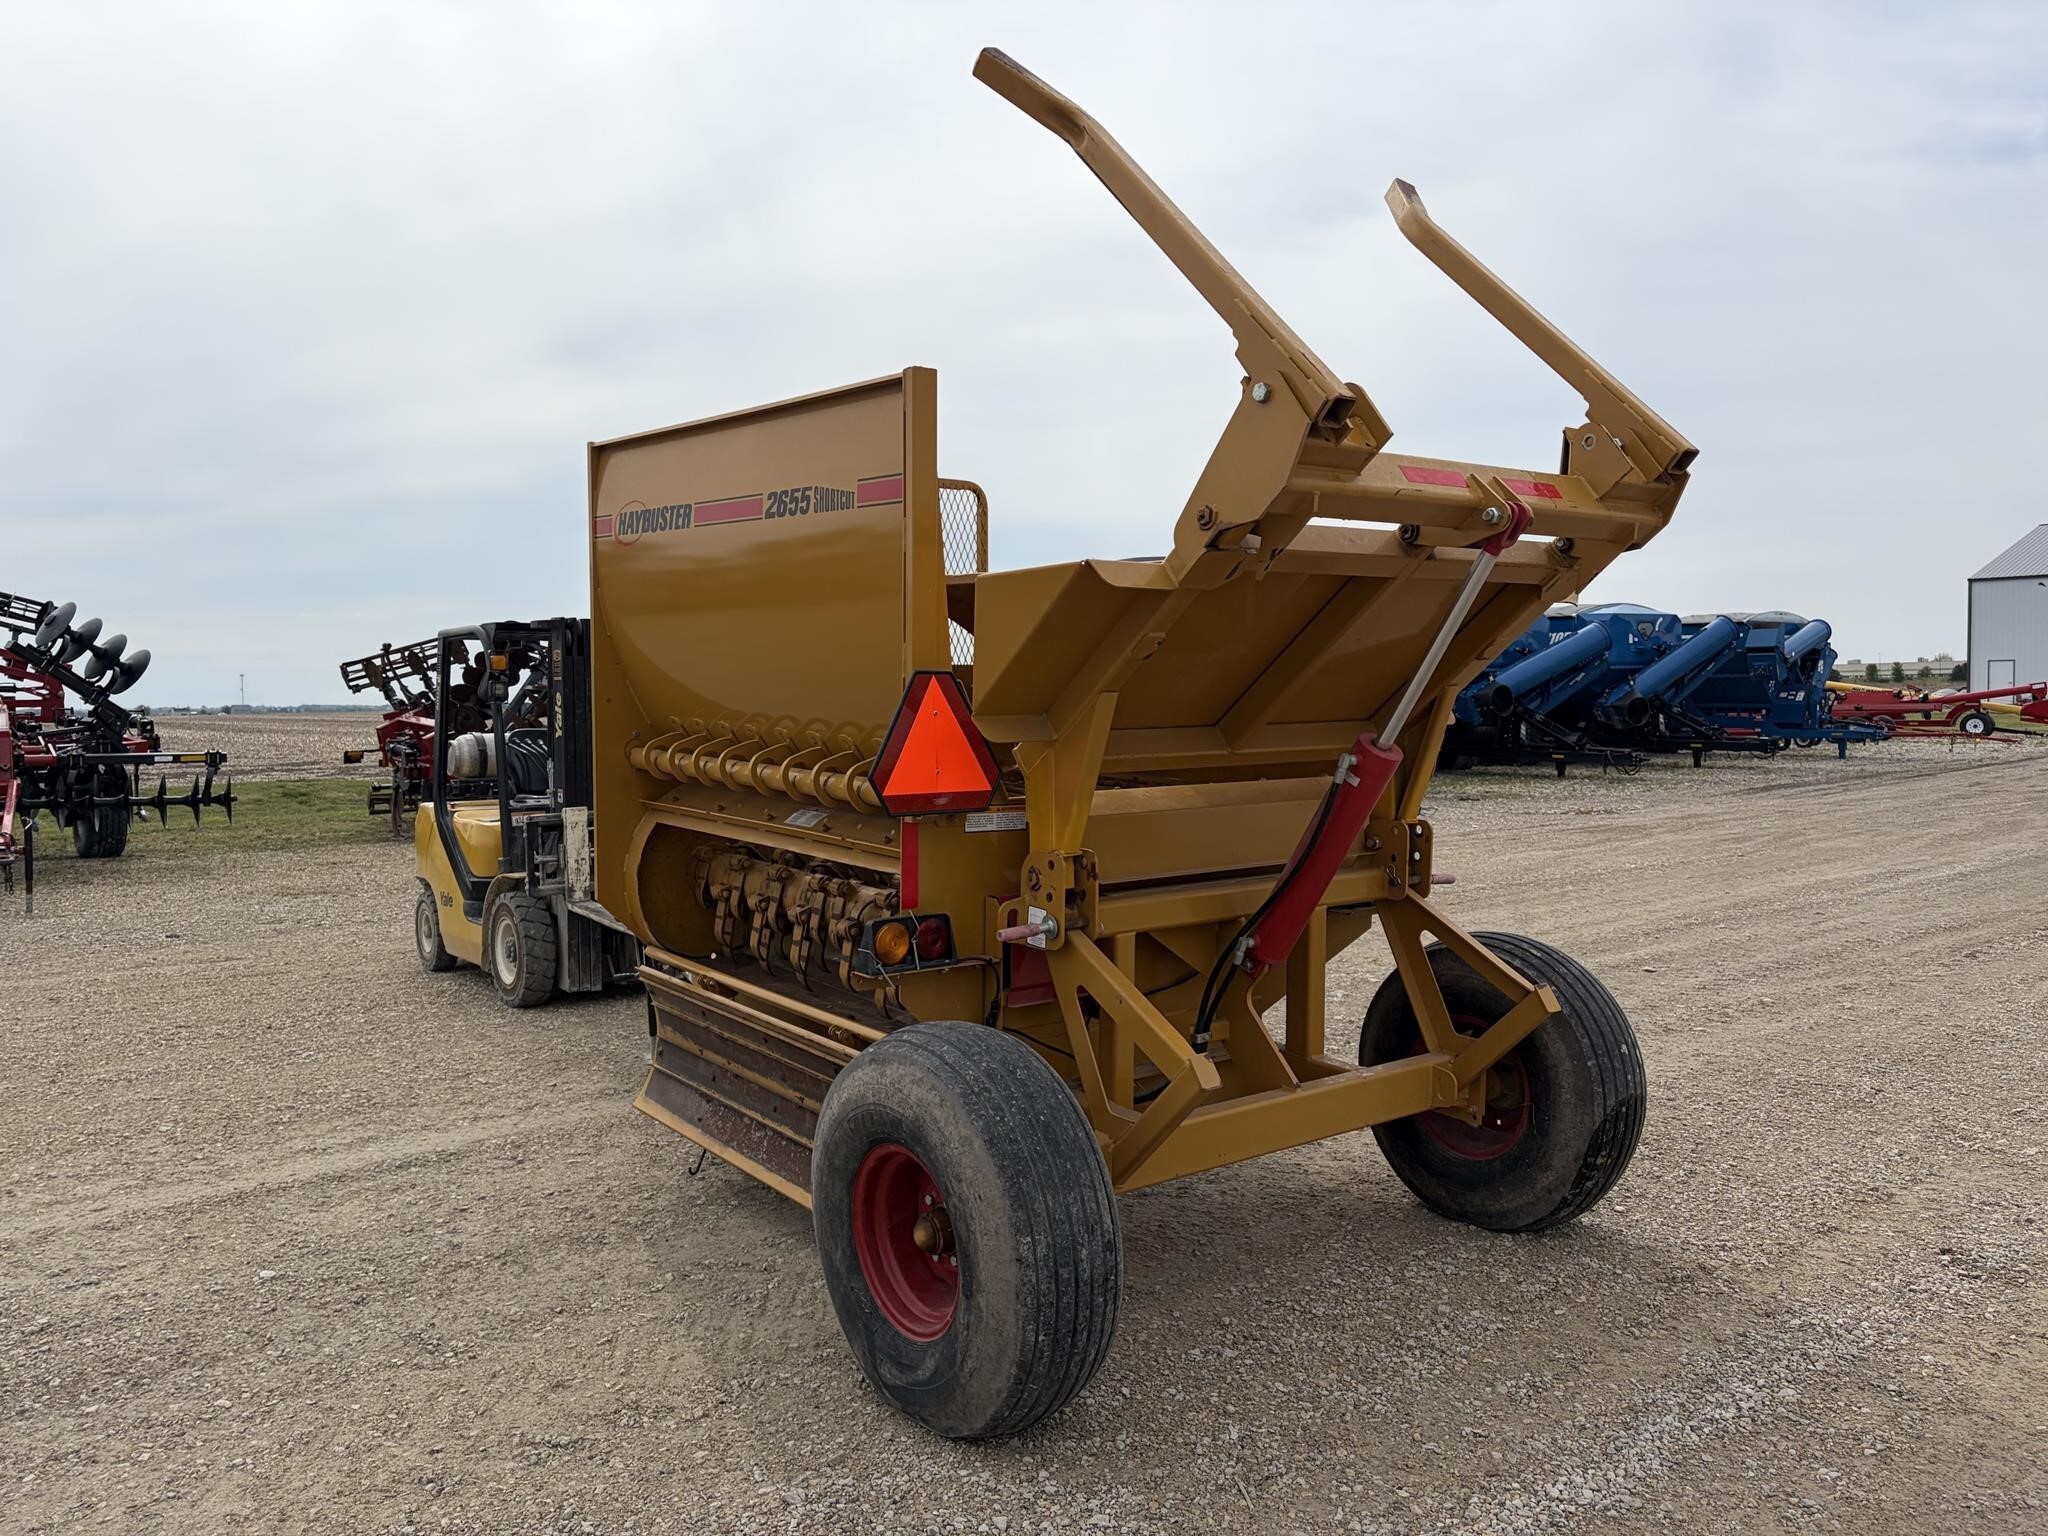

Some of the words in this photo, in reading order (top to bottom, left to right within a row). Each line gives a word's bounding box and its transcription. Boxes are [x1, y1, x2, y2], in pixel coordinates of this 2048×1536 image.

[618, 503, 692, 536] HAYBUSTER
[765, 486, 812, 519] 2655
[814, 486, 855, 513] SHORTCUT
[555, 692, 563, 738] Yale
[440, 890, 454, 907] Yale
